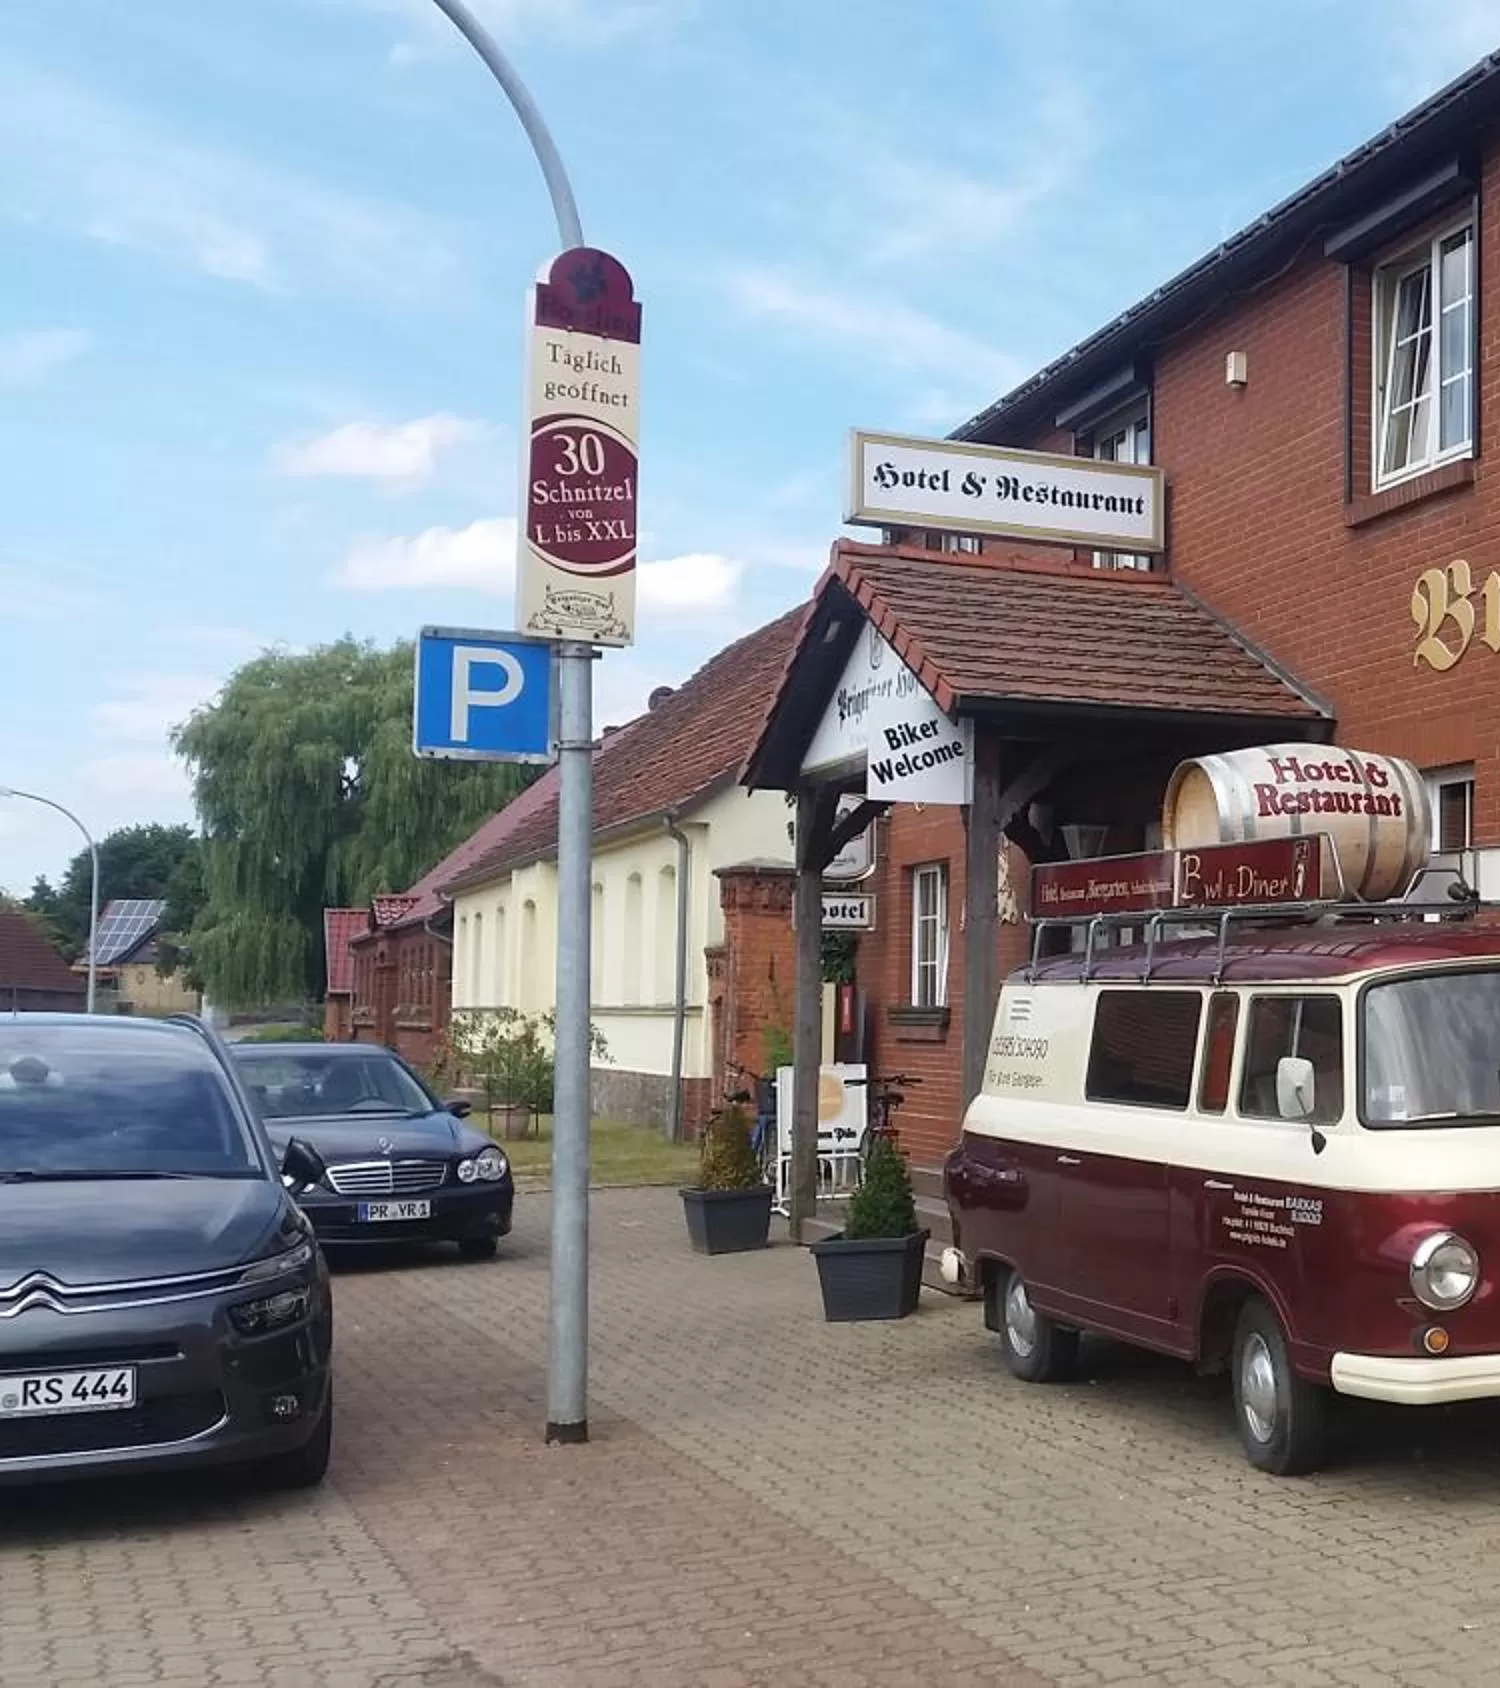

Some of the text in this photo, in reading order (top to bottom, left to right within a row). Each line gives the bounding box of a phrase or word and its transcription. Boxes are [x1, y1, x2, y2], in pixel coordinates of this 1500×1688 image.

[546, 341, 623, 375] Täglich
[544, 381, 628, 408] geöffnet
[552, 433, 605, 475] 30
[532, 477, 633, 505] Schnitzel
[873, 462, 1145, 515] Hotel & Restaurant
[567, 508, 593, 519] von
[535, 519, 634, 544] L bis XXL
[450, 645, 525, 741] P
[883, 719, 940, 751] Biker
[871, 739, 965, 785] Welcome
[1267, 757, 1389, 788] Hotel &
[1253, 783, 1403, 817] Restaurant
[1236, 865, 1289, 898] Diner
[821, 901, 865, 919] otel
[370, 1204, 389, 1218] PR
[398, 1203, 417, 1216] YR
[22, 1372, 129, 1406] RS 444
